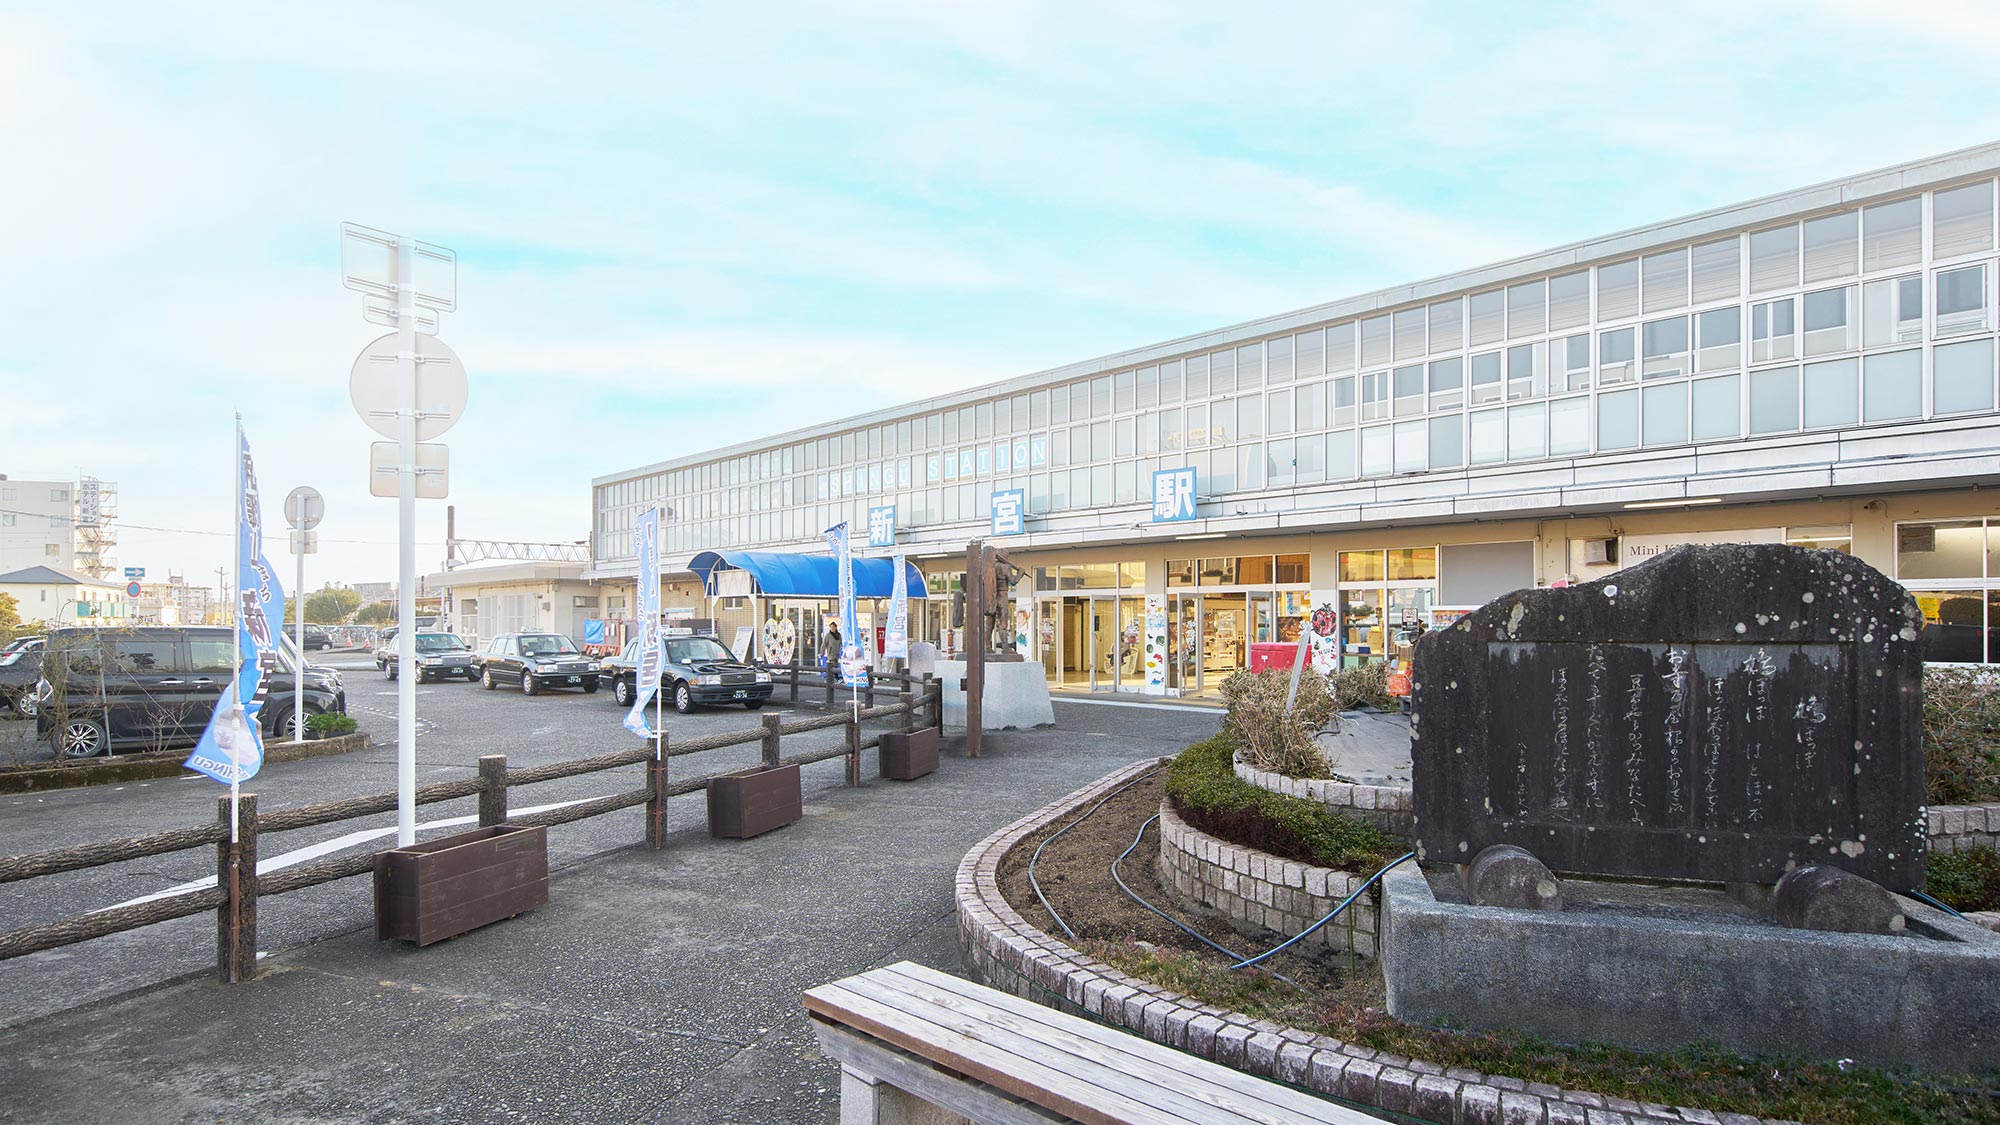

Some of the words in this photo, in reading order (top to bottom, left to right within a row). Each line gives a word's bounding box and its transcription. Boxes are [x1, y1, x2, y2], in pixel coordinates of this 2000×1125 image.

[929, 440, 1046, 478] STATION
[870, 507, 894, 545] 新
[992, 492, 1021, 534] 宮
[1154, 470, 1195, 518] 駅
[1630, 545, 1659, 556] Mini
